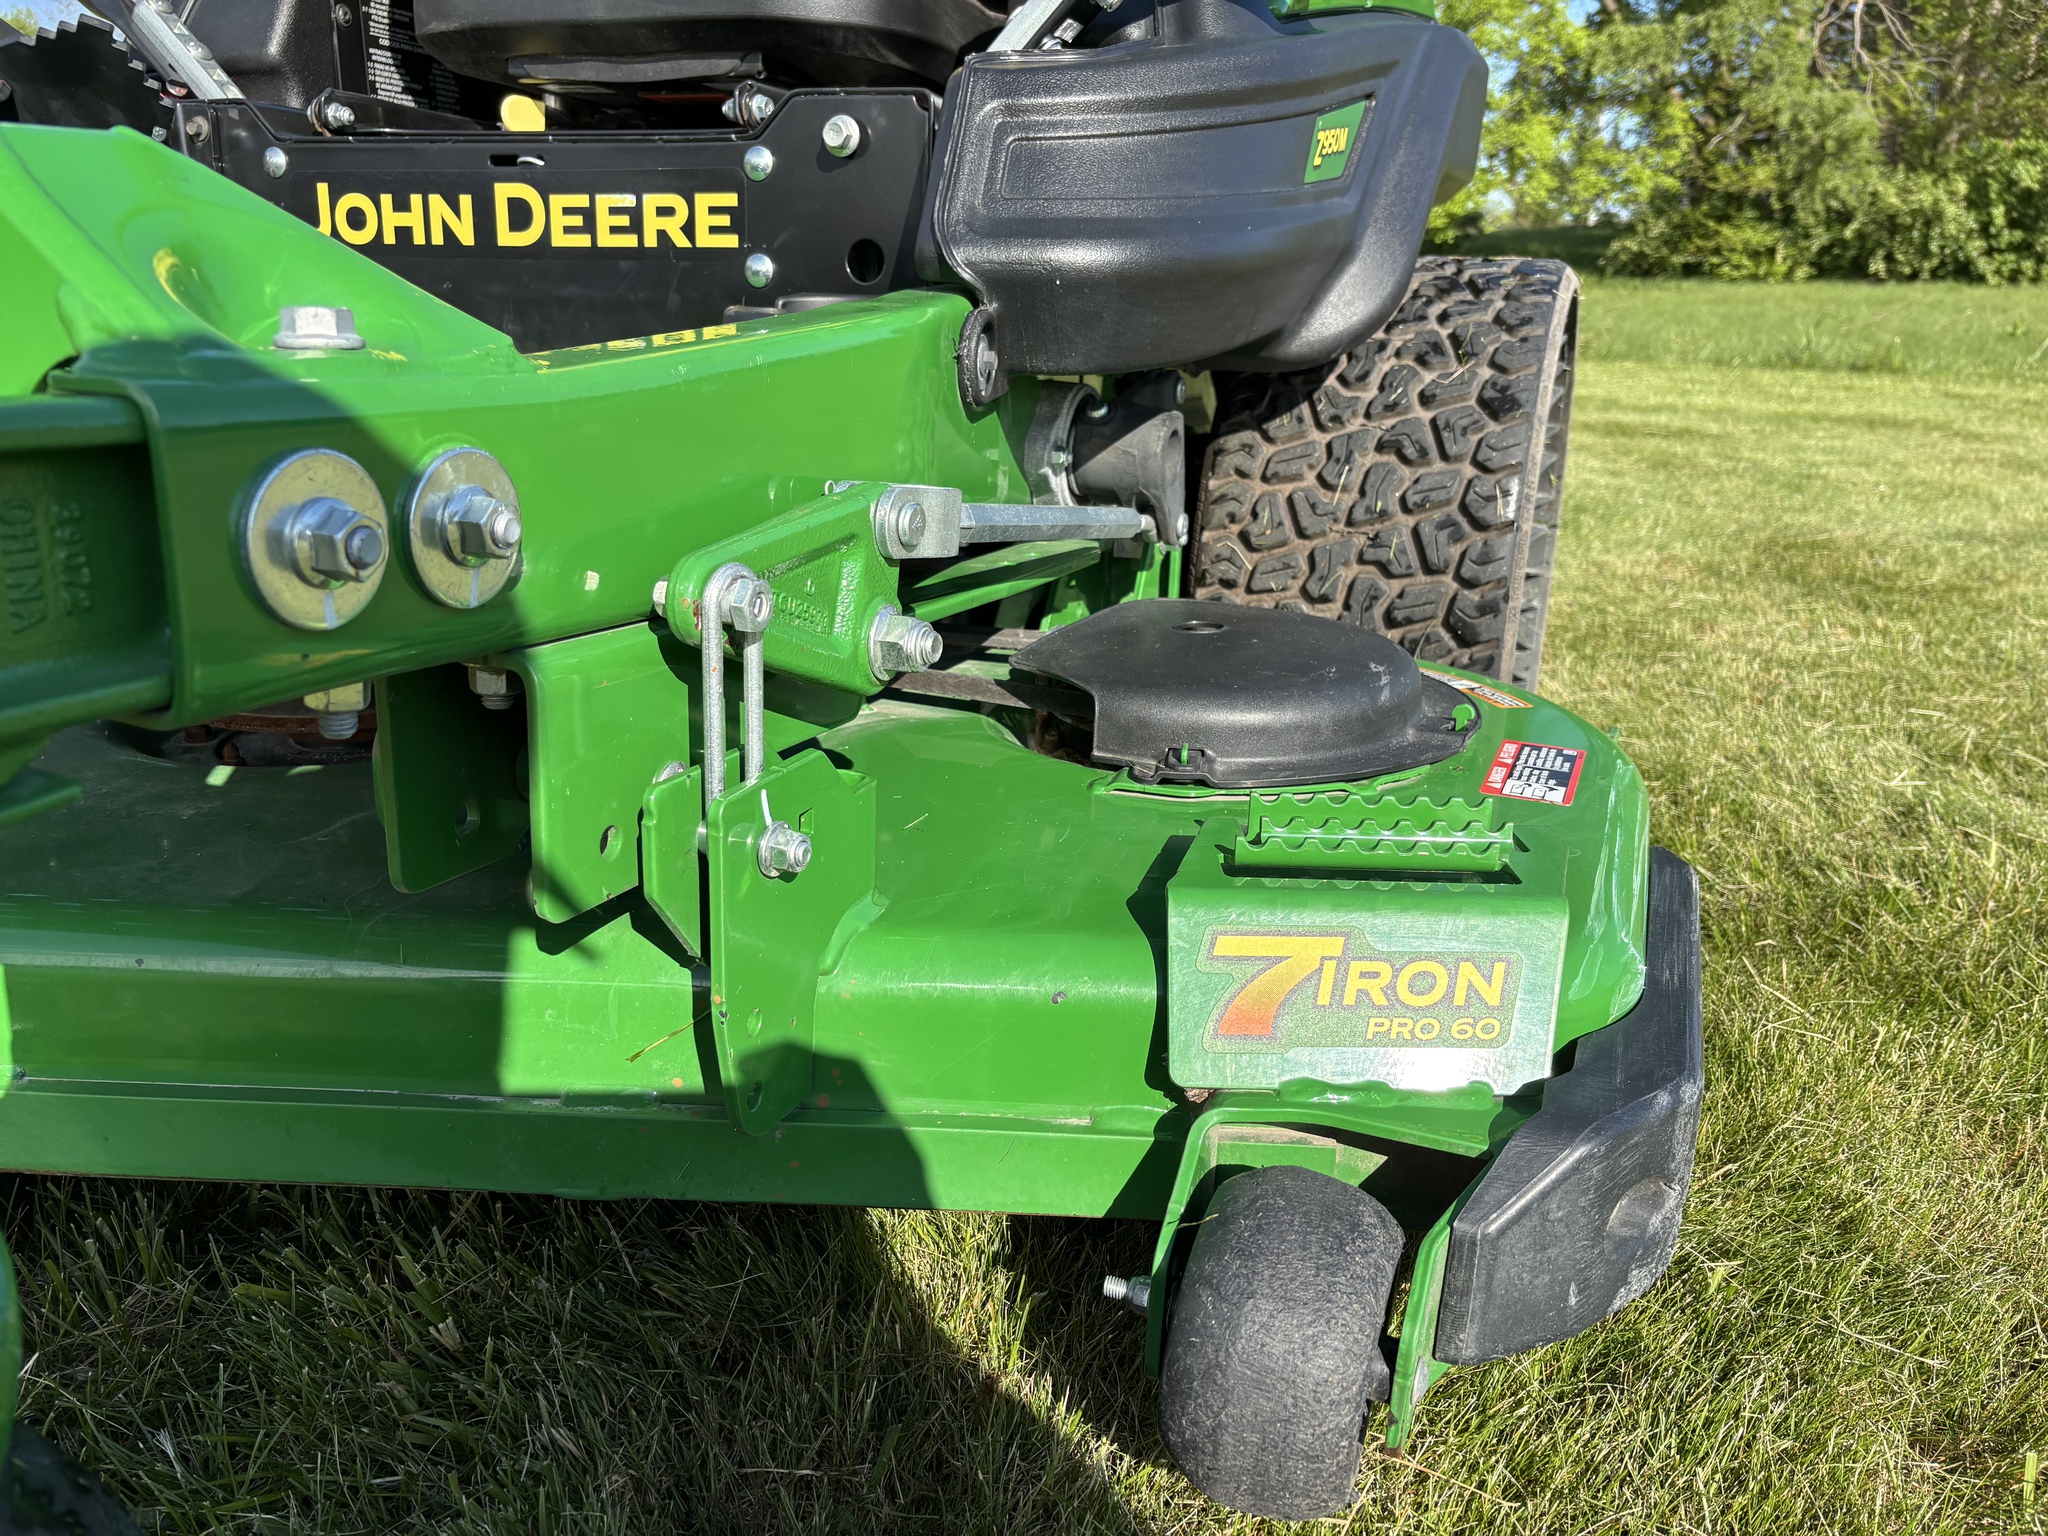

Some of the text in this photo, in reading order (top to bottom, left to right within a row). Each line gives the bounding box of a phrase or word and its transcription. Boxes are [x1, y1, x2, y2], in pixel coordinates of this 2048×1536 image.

[1313, 127, 1349, 166] Z950M
[316, 182, 739, 248] JOHN DEERE
[1316, 959, 1507, 1007] IRON
[1366, 1017, 1501, 1041] PRO 60
